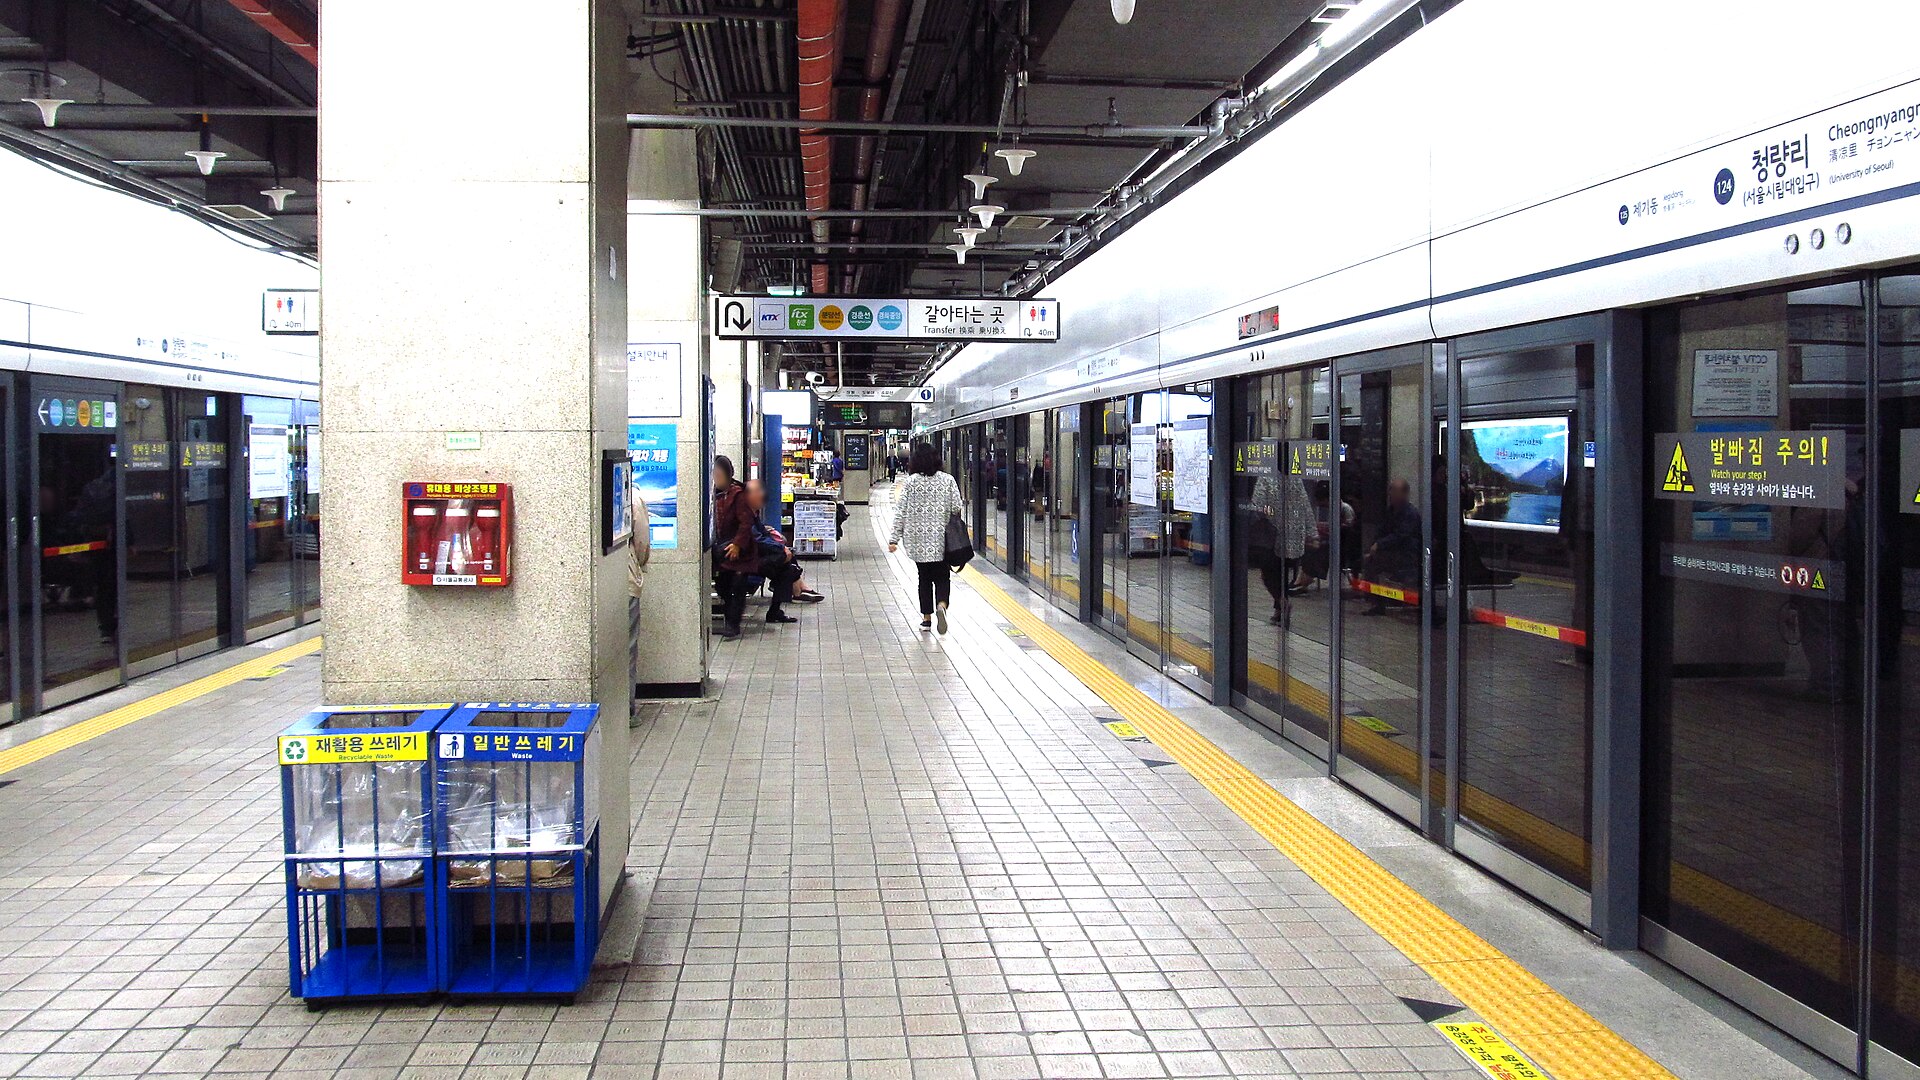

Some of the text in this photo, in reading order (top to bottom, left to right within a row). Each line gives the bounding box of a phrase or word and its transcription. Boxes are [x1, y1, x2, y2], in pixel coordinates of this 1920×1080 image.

[1752, 133, 1809, 183] 청량리
[1829, 169, 1863, 184] (University
[1716, 179, 1732, 195] 124
[1743, 172, 1820, 207] (서울시립대입구)
[1633, 198, 1658, 217] 제기동
[761, 313, 781, 321] KTX
[925, 305, 1005, 324] 갈아타는 곳
[923, 325, 956, 335] Transfer
[1710, 436, 1828, 466] 발빠짐 주의!
[1711, 469, 1730, 479] Watch
[1732, 471, 1746, 480] your
[426, 483, 497, 494] 휴대용 비상조명등
[1709, 482, 1816, 499] 열차와 승강장 사이가 넓습니다.
[316, 735, 418, 753] 재활용 쓰레기
[1470, 1026, 1500, 1044] 주의
